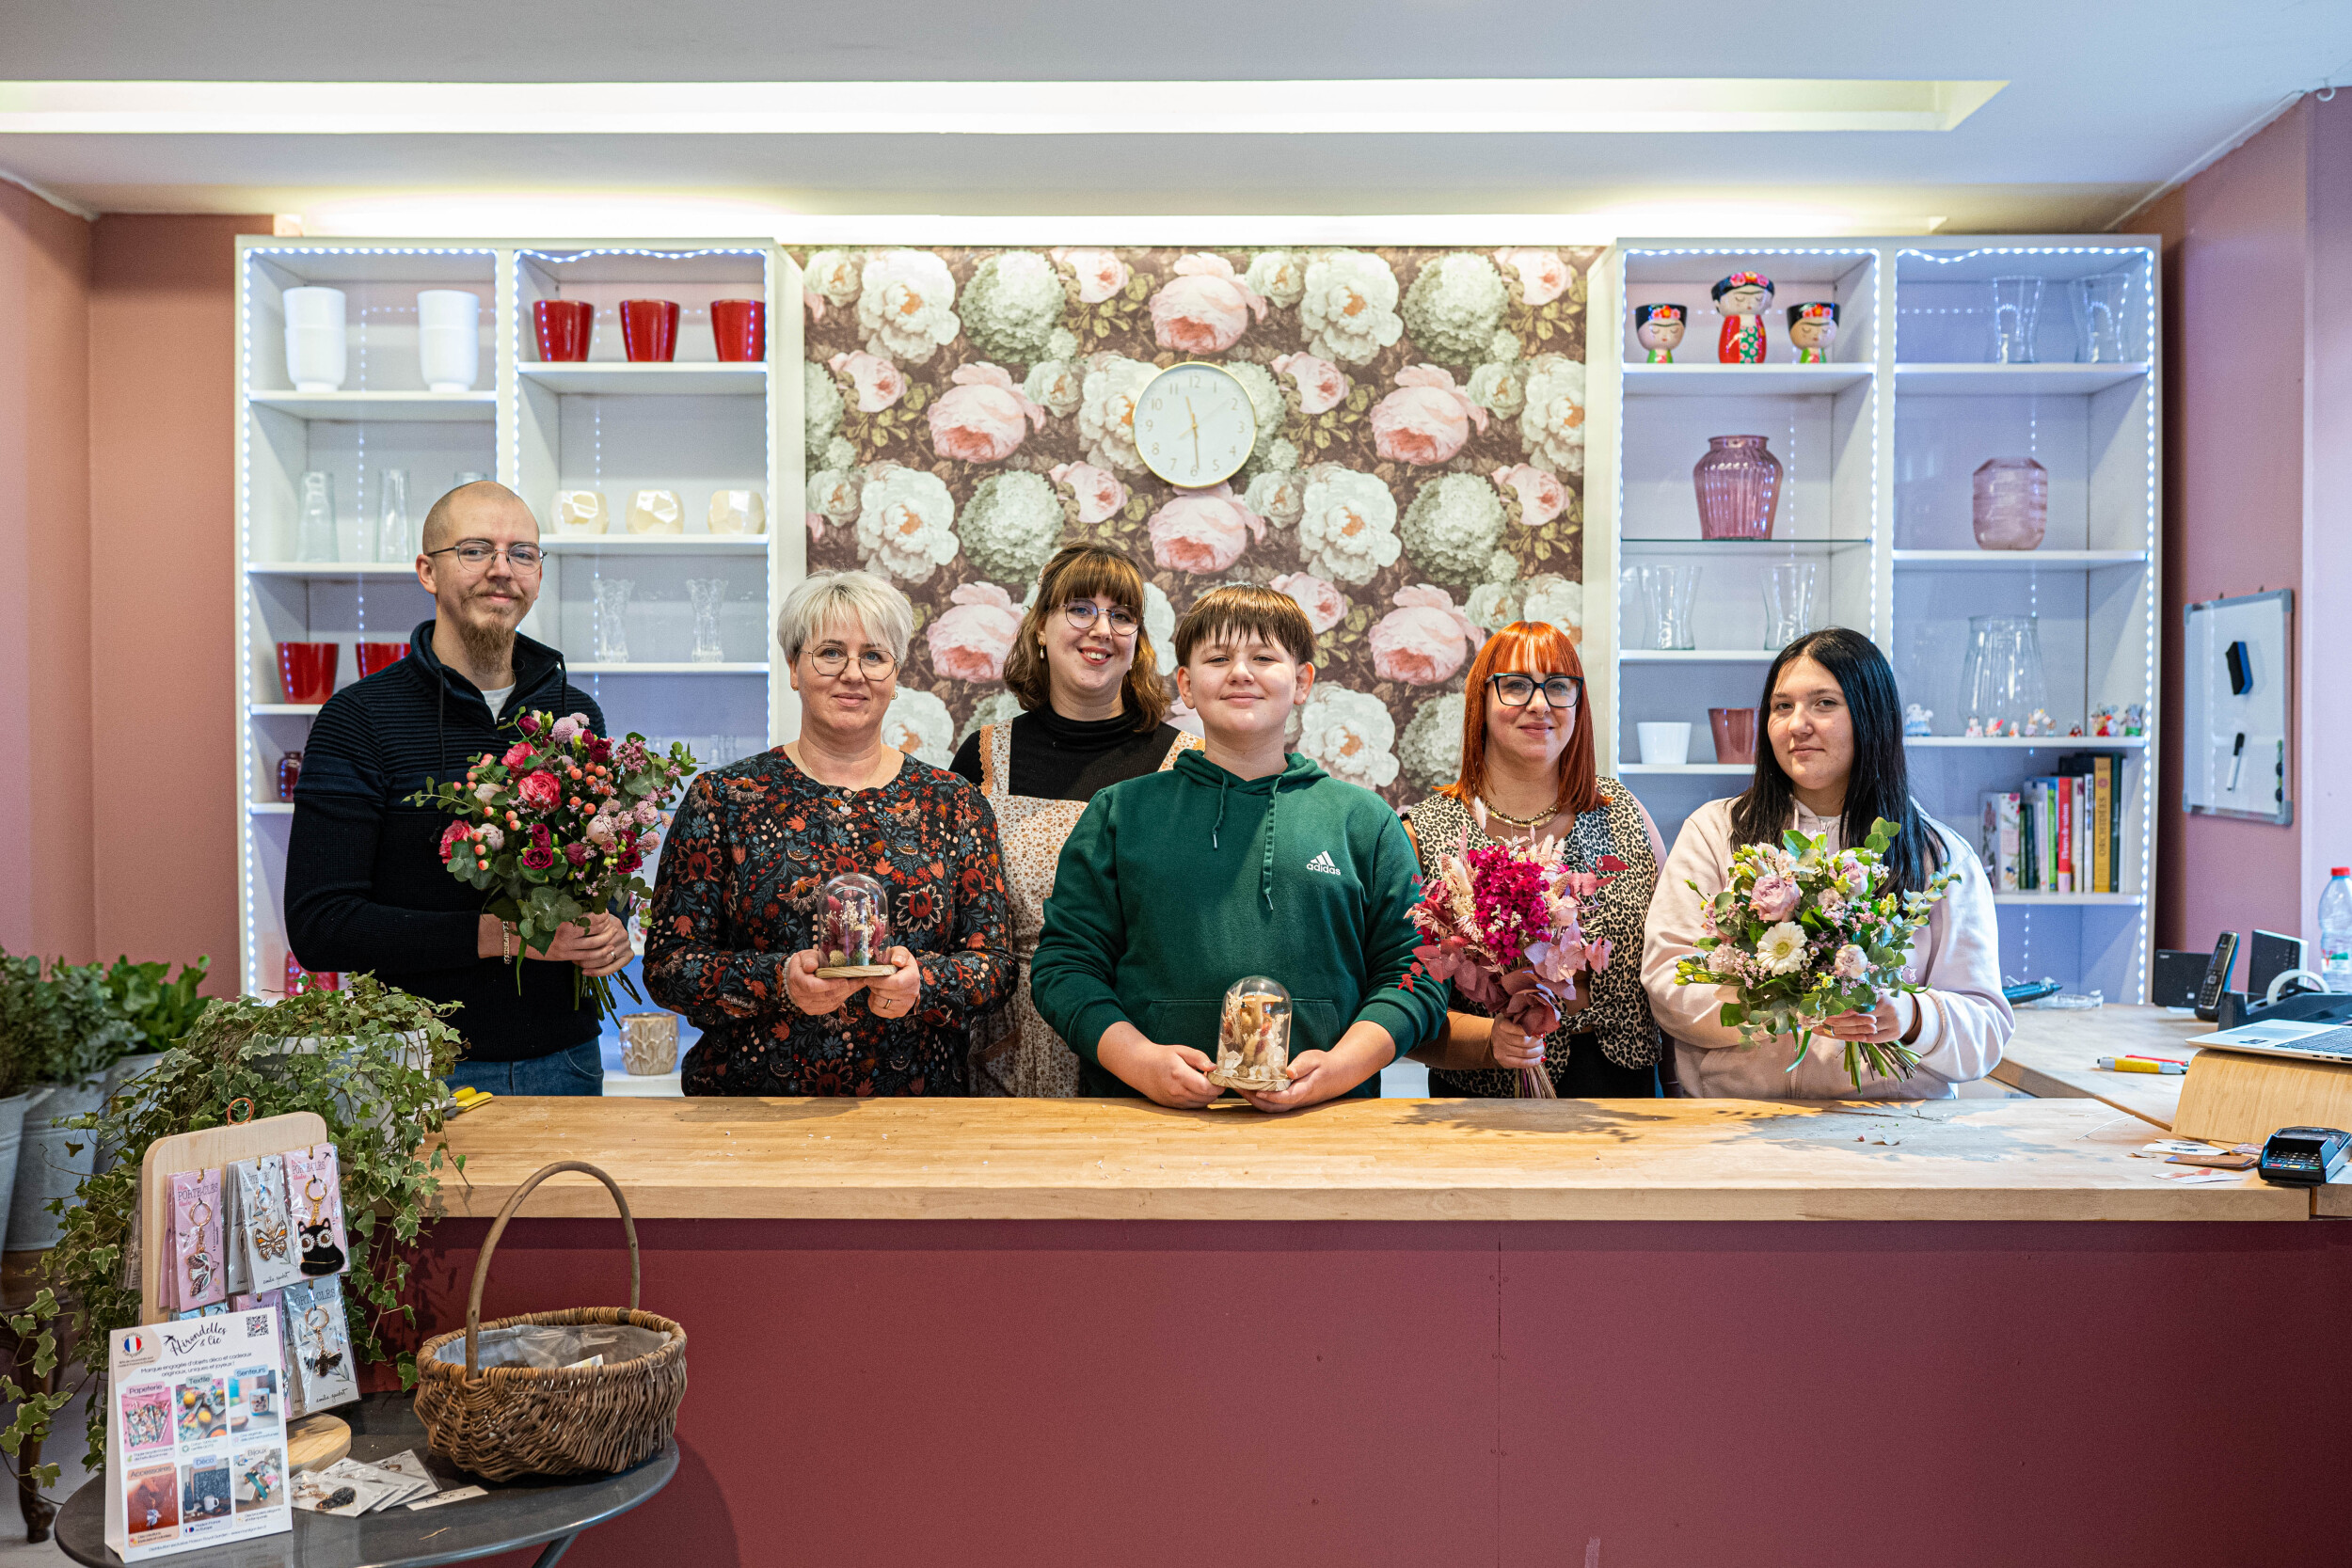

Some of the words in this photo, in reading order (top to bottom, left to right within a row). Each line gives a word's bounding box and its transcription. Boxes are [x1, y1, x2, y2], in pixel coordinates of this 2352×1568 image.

[1188, 375, 1200, 388] 12
[1169, 383, 1179, 395] 11
[1151, 398, 1163, 411] 10
[1231, 398, 1239, 411] 2
[1145, 420, 1153, 432] 9
[1237, 421, 1245, 434] 3
[1152, 442, 1160, 455] 8
[1229, 446, 1236, 456] 4
[1169, 458, 1177, 471] 7
[1190, 464, 1199, 477] 6
[1213, 459, 1220, 471] 5
[1306, 863, 1342, 876] adidas
[293, 1288, 336, 1307] ORT-CLÉS
[170, 1322, 227, 1356] Hirondelles
[208, 1336, 221, 1345] Cie
[140, 1365, 163, 1374] Marque
[229, 1352, 252, 1360] cadeaux
[187, 1365, 209, 1374] uniques
[236, 1367, 266, 1377] Senteurs
[188, 1375, 211, 1384] Textile
[129, 1384, 163, 1395] Papeterie
[247, 1448, 267, 1458] Bijoux
[196, 1457, 215, 1466] Déco
[130, 1465, 172, 1479] Accessoires
